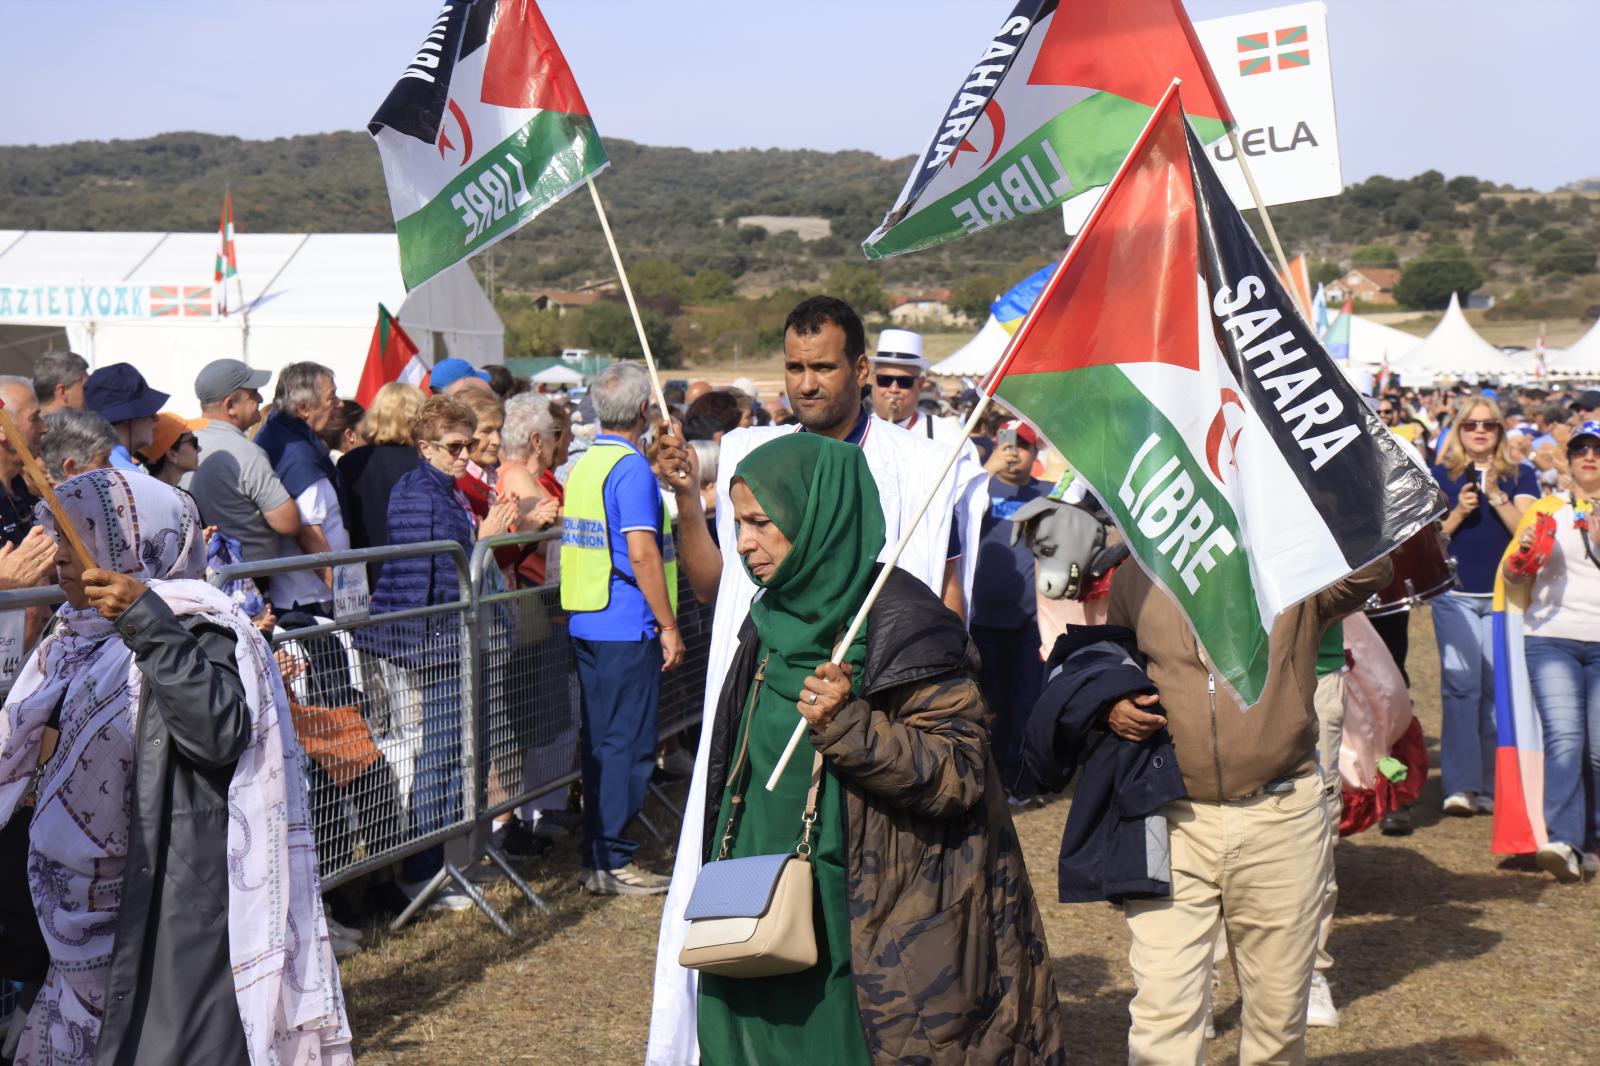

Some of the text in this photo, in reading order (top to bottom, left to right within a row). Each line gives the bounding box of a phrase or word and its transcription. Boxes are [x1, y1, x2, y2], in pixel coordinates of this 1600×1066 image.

[927, 16, 1031, 169] SAHARA
[1213, 275, 1362, 471] SAHARA
[1118, 432, 1237, 596] LIBRE
